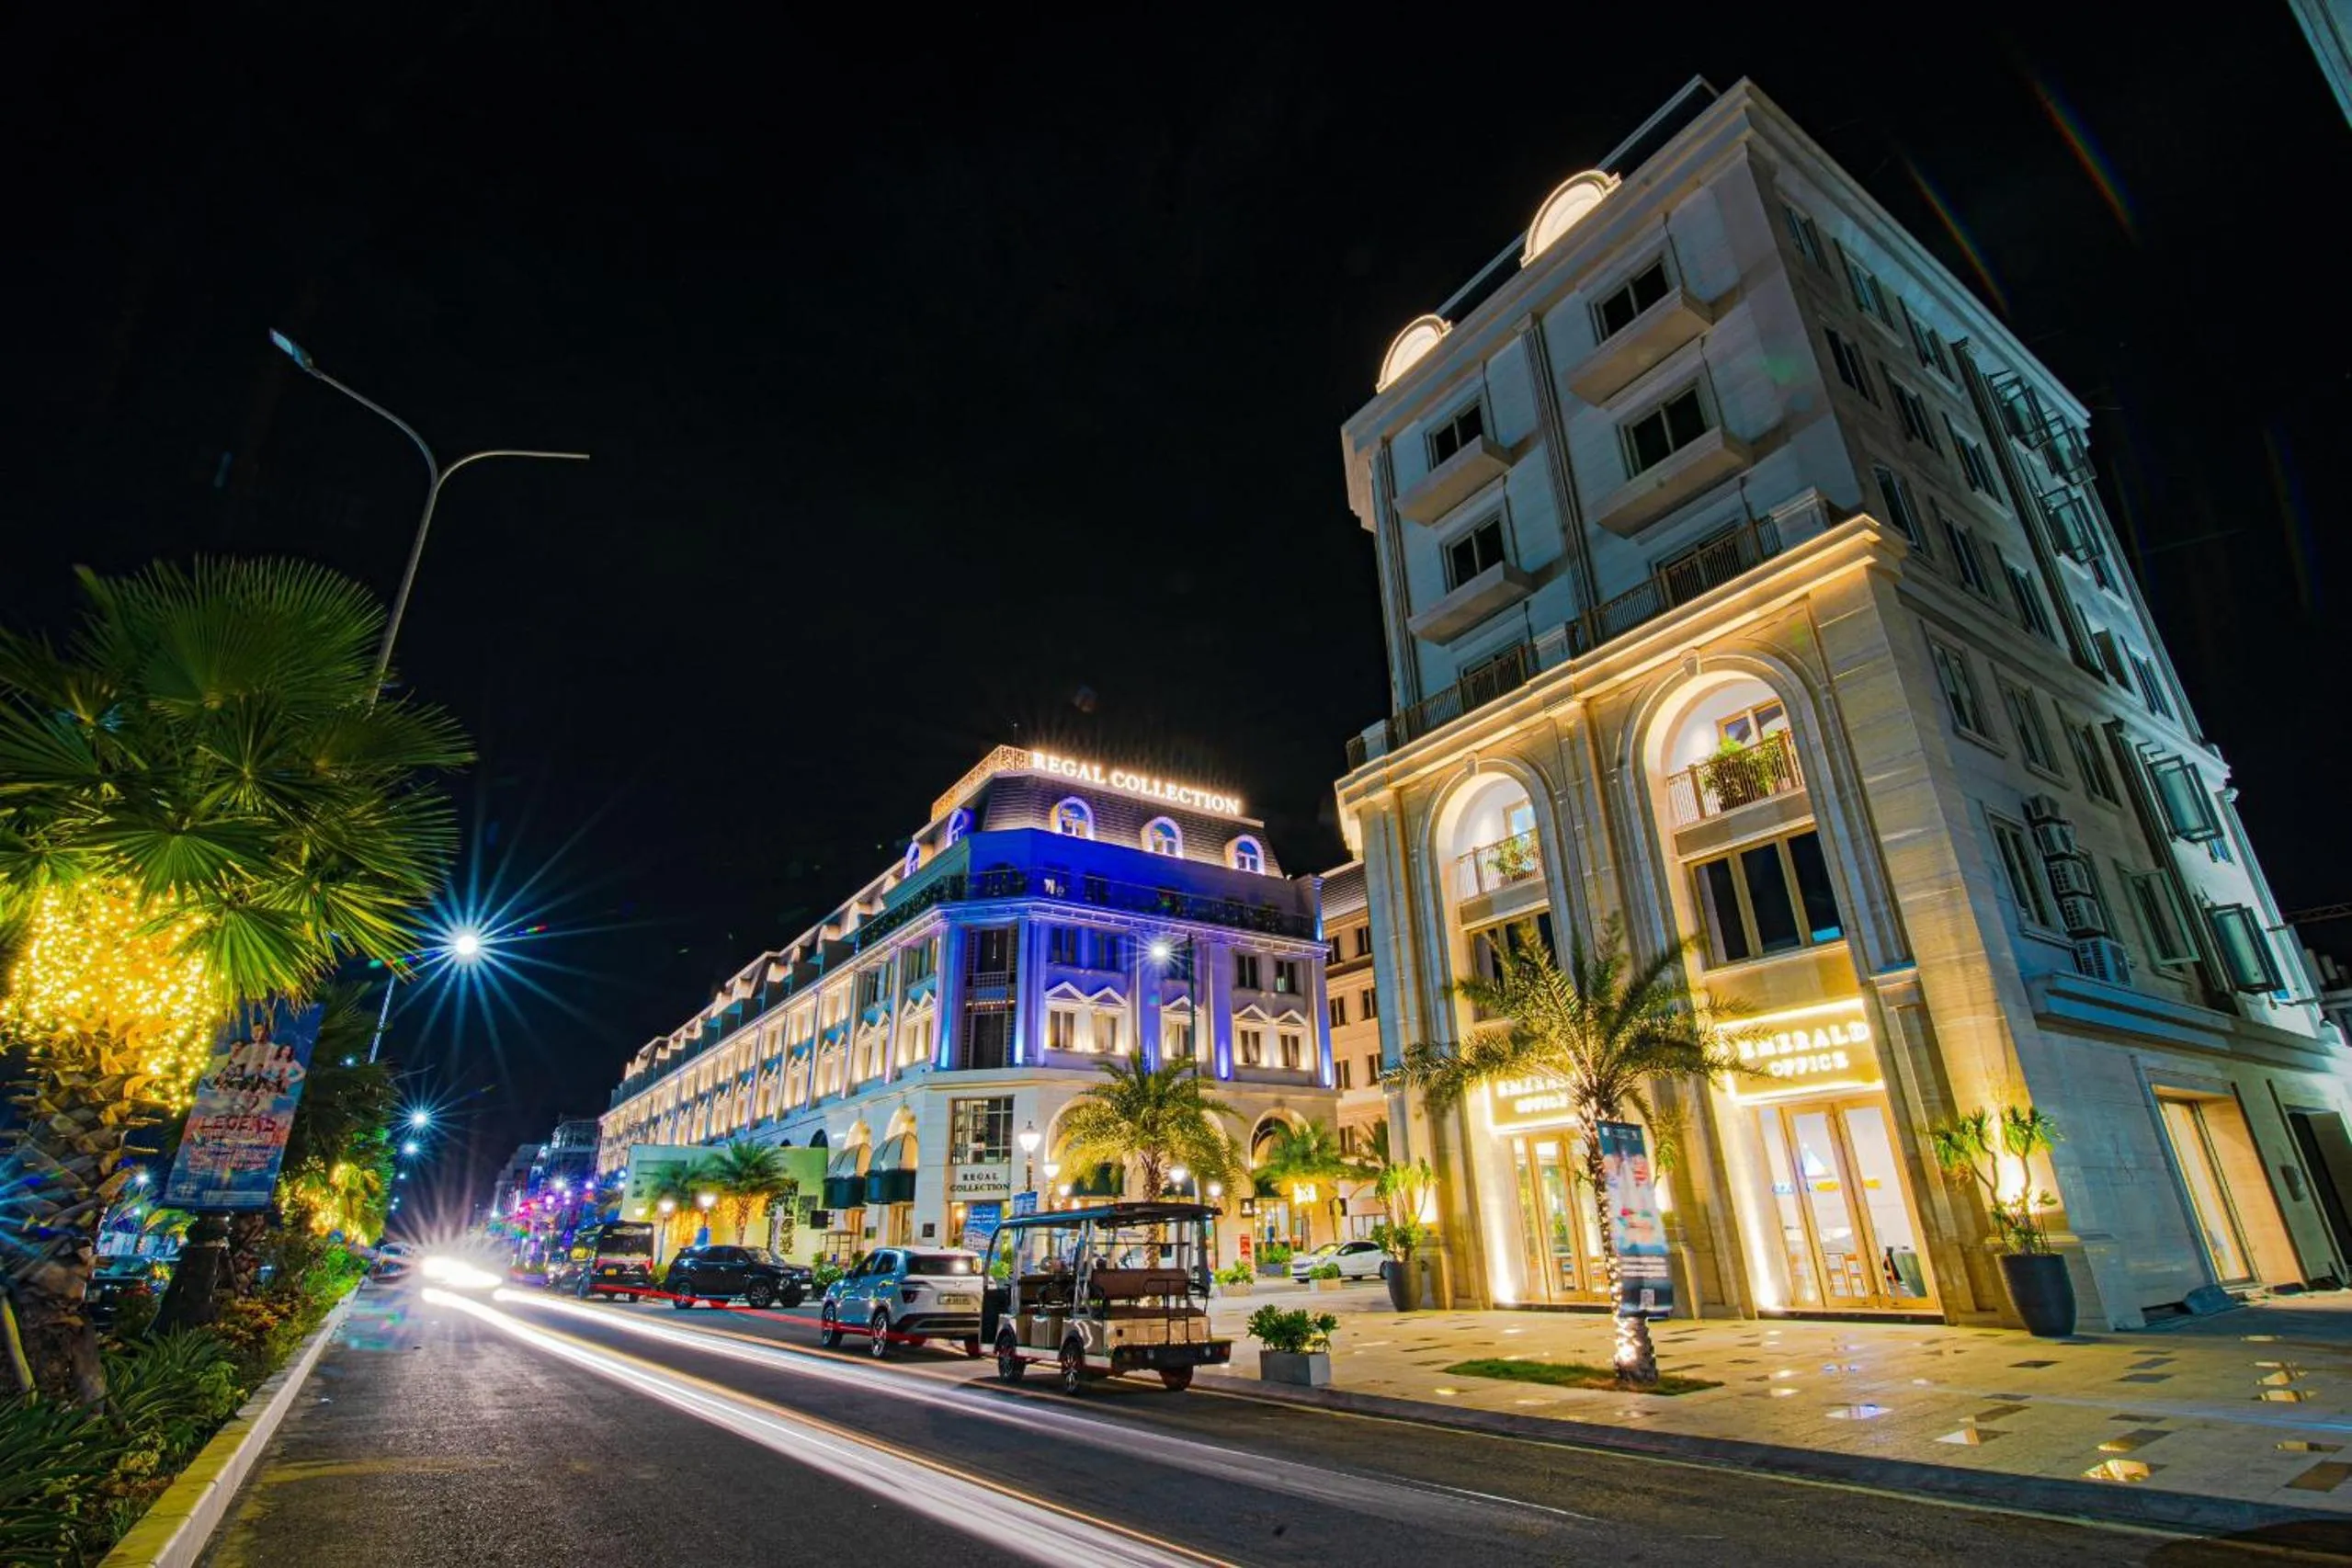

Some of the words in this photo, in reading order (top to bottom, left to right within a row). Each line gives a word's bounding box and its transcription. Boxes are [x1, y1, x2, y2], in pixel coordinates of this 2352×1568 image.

[1032, 751, 1105, 783] REGAL
[1109, 769, 1240, 816] COLLECTION
[1736, 1021, 1871, 1060] EMERALD
[1767, 1051, 1849, 1077] OFFICE
[949, 1182, 1010, 1192] COLLECTION
[962, 1172, 998, 1181] REGAL
